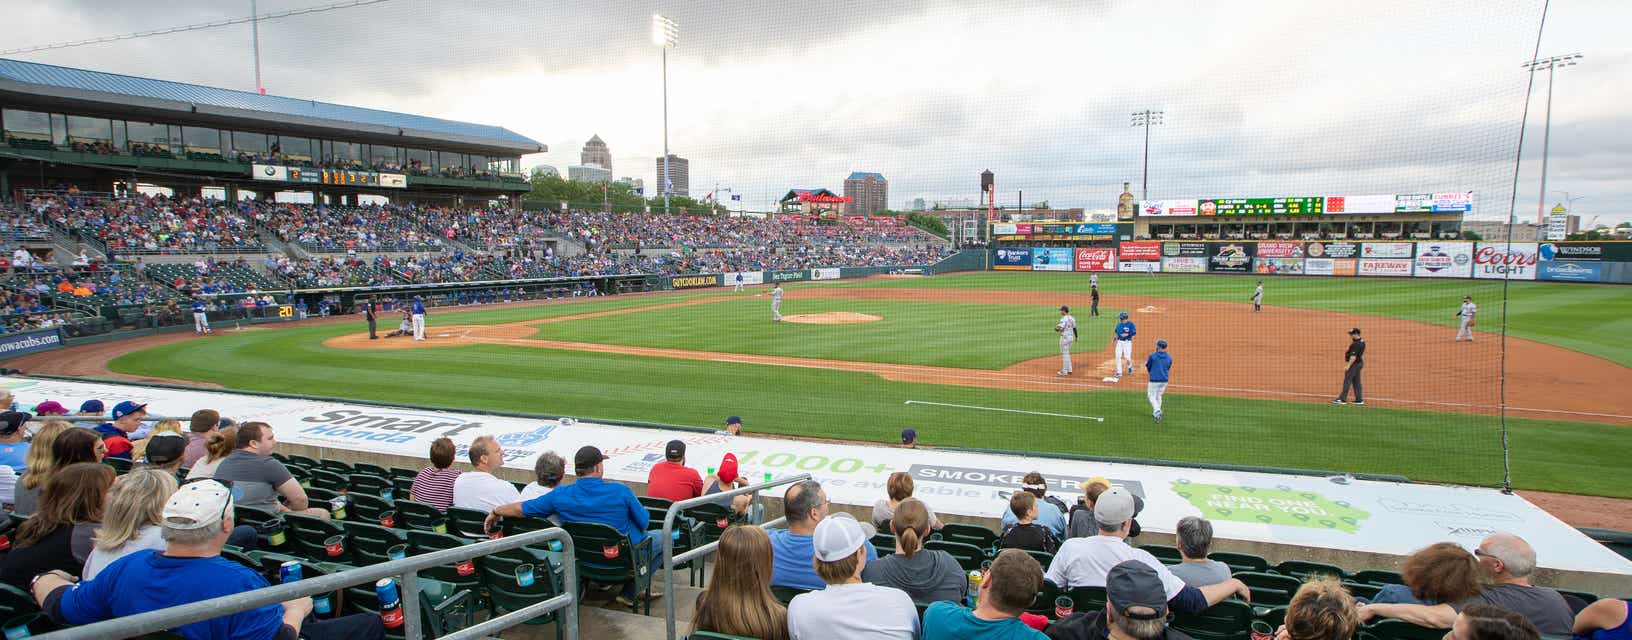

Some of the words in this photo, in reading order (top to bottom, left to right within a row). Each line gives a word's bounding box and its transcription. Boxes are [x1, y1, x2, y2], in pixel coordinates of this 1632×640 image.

[1475, 247, 1537, 266] Coors
[1484, 265, 1525, 275] LIGHT
[279, 305, 293, 318] 20
[0, 335, 60, 352] owacubs.com
[301, 410, 483, 437] Smart
[302, 424, 416, 444] Honda
